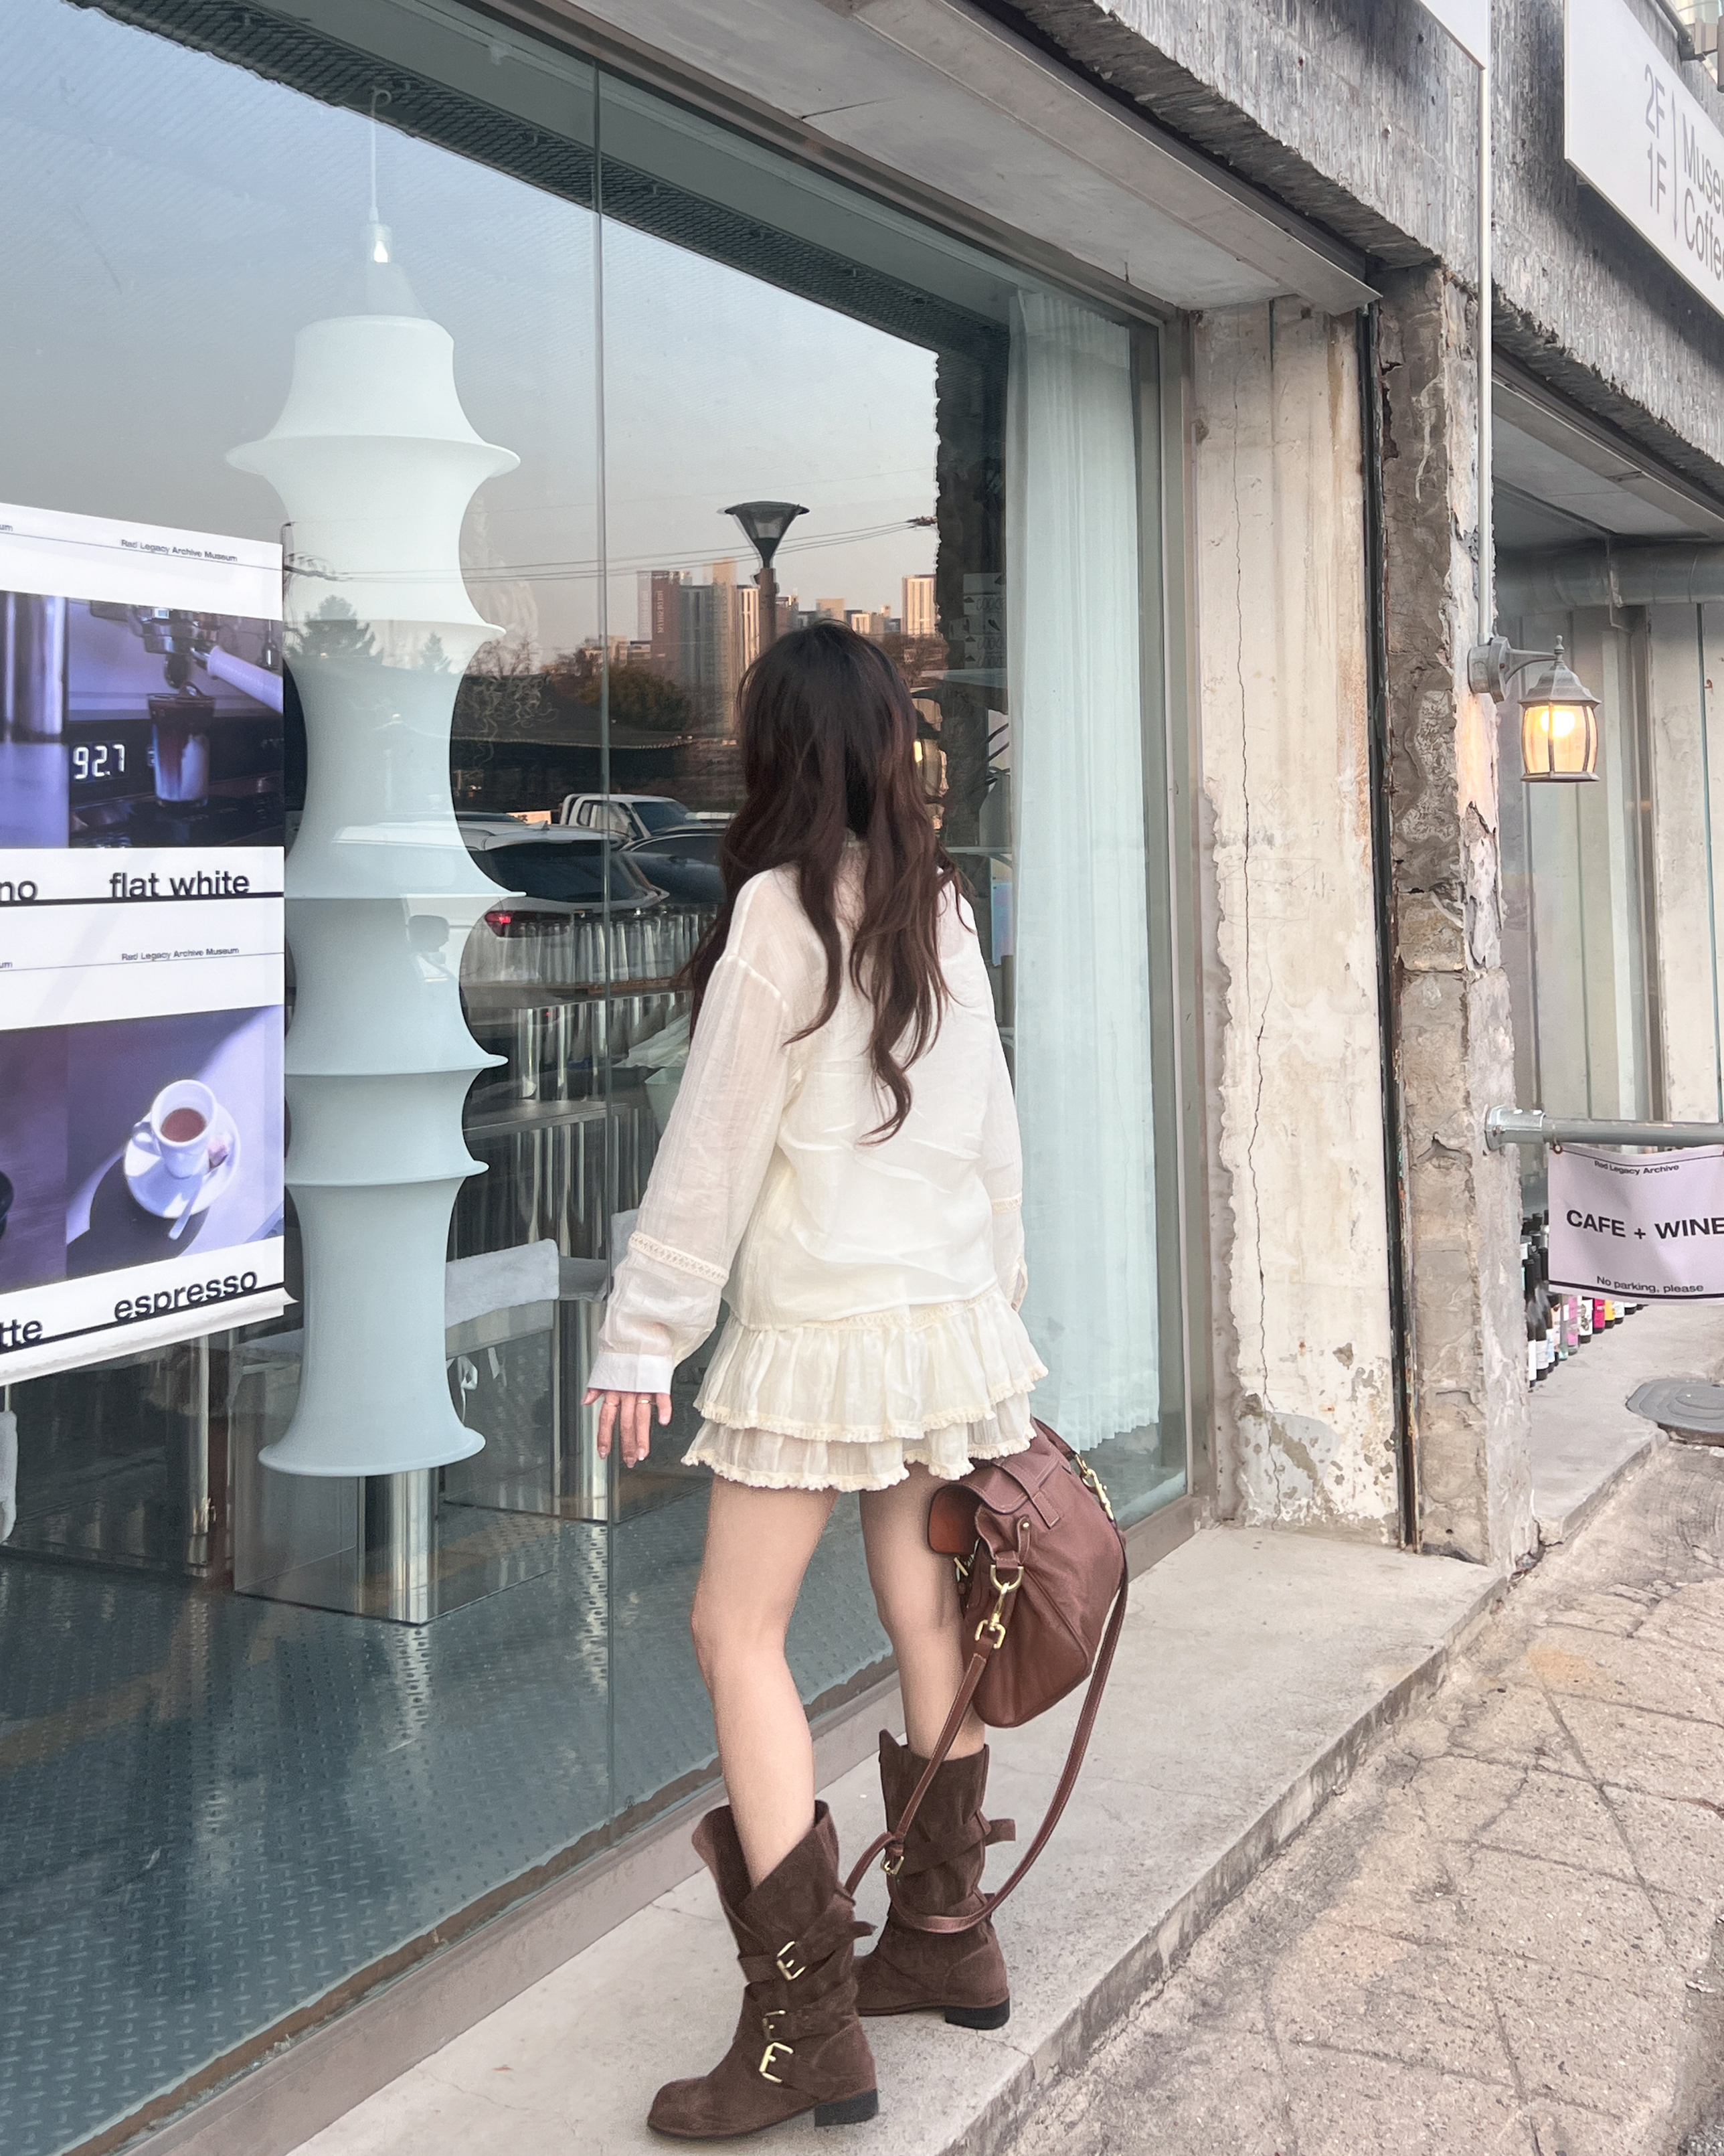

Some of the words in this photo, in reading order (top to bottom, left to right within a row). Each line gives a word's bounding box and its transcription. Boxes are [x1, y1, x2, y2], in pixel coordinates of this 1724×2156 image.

[1644, 64, 1665, 139] 2F
[1647, 141, 1666, 214] 1F
[1684, 187, 1724, 281] Coffe
[140, 542, 169, 554] Legacy
[172, 546, 203, 558] Archive
[204, 551, 238, 562] Museum
[73, 744, 126, 780] 92.7
[109, 872, 160, 898] flat
[169, 871, 250, 897] white
[141, 952, 171, 962] Legacy
[173, 949, 203, 958] Archive
[206, 947, 239, 956] Museum
[1610, 1165, 1640, 1175] Legacy
[1643, 1164, 1679, 1174] Archive
[1566, 1210, 1626, 1238] CAFE
[1654, 1217, 1724, 1239] WINE
[114, 1271, 258, 1321] espresso
[1597, 1276, 1612, 1287] No
[1614, 1280, 1660, 1293] parking,
[1663, 1284, 1704, 1293] please
